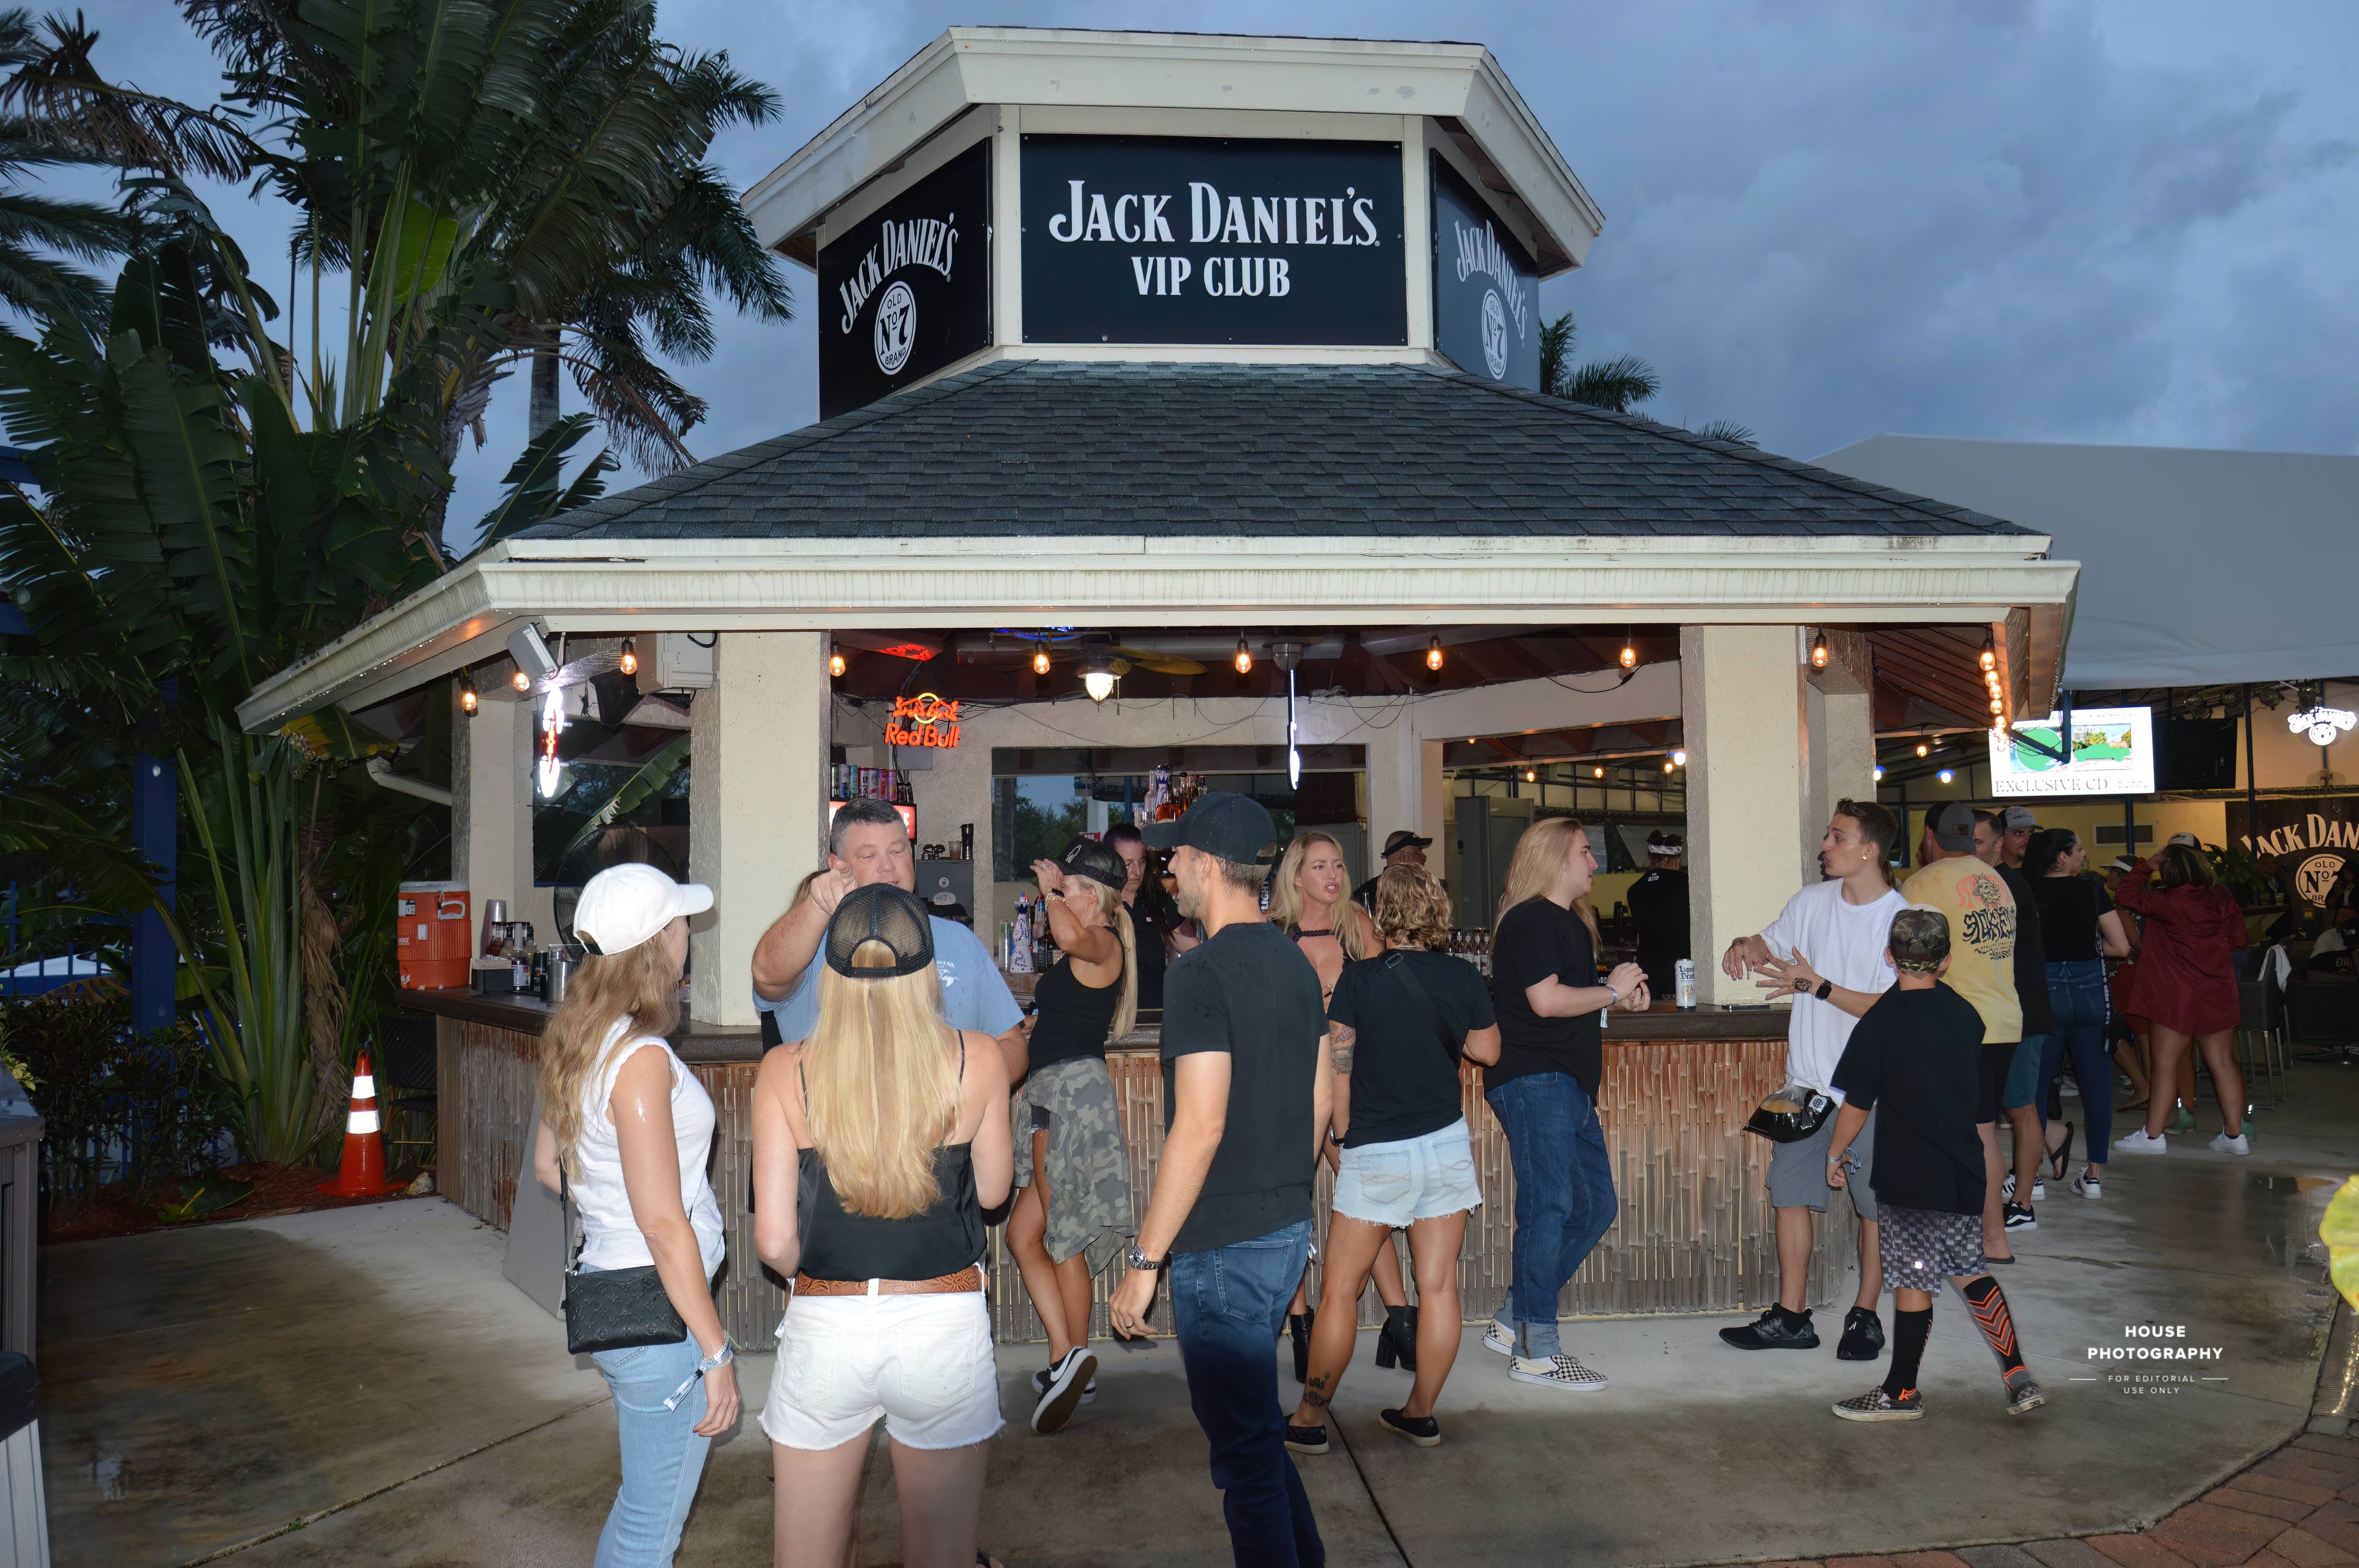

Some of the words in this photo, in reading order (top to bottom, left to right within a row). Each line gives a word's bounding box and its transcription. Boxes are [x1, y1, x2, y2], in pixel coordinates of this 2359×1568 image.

[1048, 180, 1175, 243] JACK
[1188, 182, 1377, 246] DANIEL'S
[1454, 220, 1487, 283] JACK
[839, 243, 883, 334] JACK
[882, 212, 959, 278] DANIEL'S
[1131, 255, 1192, 295] VIP
[1203, 257, 1291, 297] CLUB
[887, 293, 902, 310] OLD
[885, 347, 906, 365] BRAND
[885, 722, 923, 746] Red
[923, 725, 960, 748] Bull
[1996, 779, 2081, 792] EXCLUSIVE
[2086, 778, 2108, 790] CD
